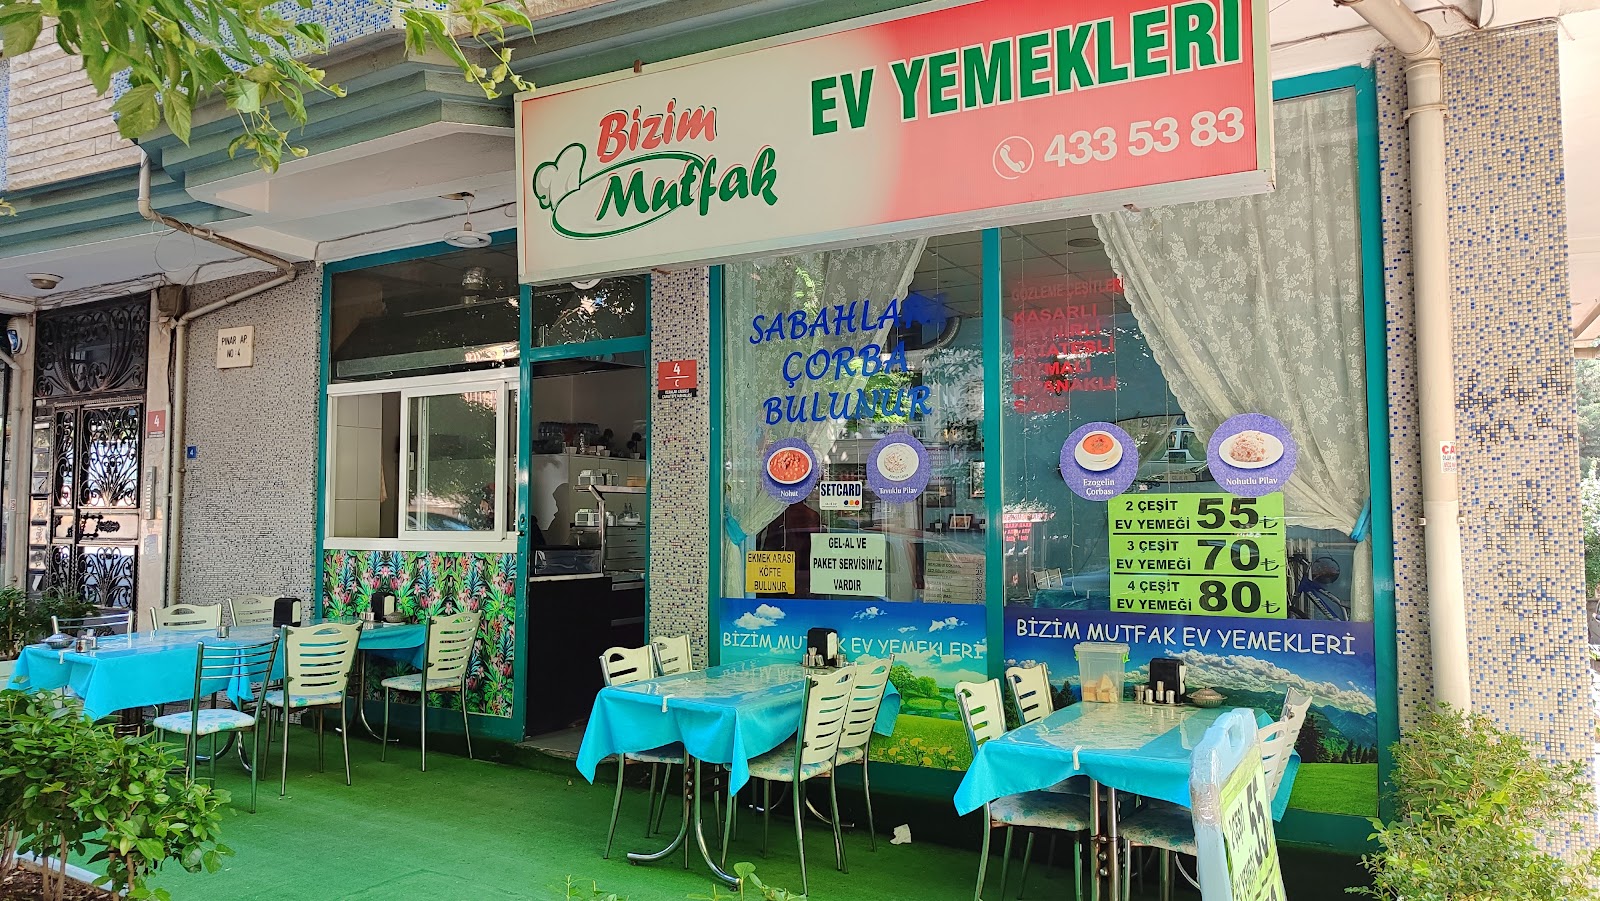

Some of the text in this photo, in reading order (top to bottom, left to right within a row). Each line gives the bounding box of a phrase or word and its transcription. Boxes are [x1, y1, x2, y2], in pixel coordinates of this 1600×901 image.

[811, 68, 876, 136] EV
[597, 98, 718, 163] Bizim
[1044, 107, 1245, 168] 433 53 83
[596, 145, 779, 221] Mutfak
[749, 289, 946, 344] SABAHLA
[673, 362, 681, 375] 4
[782, 340, 907, 388] ÇORBA
[674, 379, 680, 387] C
[763, 386, 932, 425] BULUNUR
[153, 414, 160, 427] 4
[1083, 478, 1115, 487] Ezogelin
[1226, 476, 1278, 486] Nohutlu Pilav
[780, 489, 799, 498] Nohut
[821, 483, 861, 497] SETCARD
[903, 486, 918, 494] Pilav
[1086, 487, 1114, 496] Çorbası
[1126, 498, 1178, 514] 2 ÇEŞİT
[1115, 516, 1190, 530] EV YEMEĞİ
[828, 537, 867, 549] GEL-AL VE
[1127, 538, 1179, 554] 3 ÇEŞİT
[747, 553, 794, 564] EKMEK ARASI
[813, 555, 883, 571] PAKET SERVİSİMİZ
[1116, 557, 1191, 571] EV YEMEĞİ
[759, 565, 781, 577] KÖFTE
[754, 580, 787, 591] BULUNUR
[833, 578, 862, 591] VARDIR
[1127, 578, 1180, 594] 4 ÇEŞİT
[1117, 596, 1192, 611] EV YEMEĞİ
[1016, 616, 1356, 656] BİZİM MUTFAK EV YEMEKLERİ
[723, 630, 987, 660] BİZİM MUK EV YEMEKLERİ
